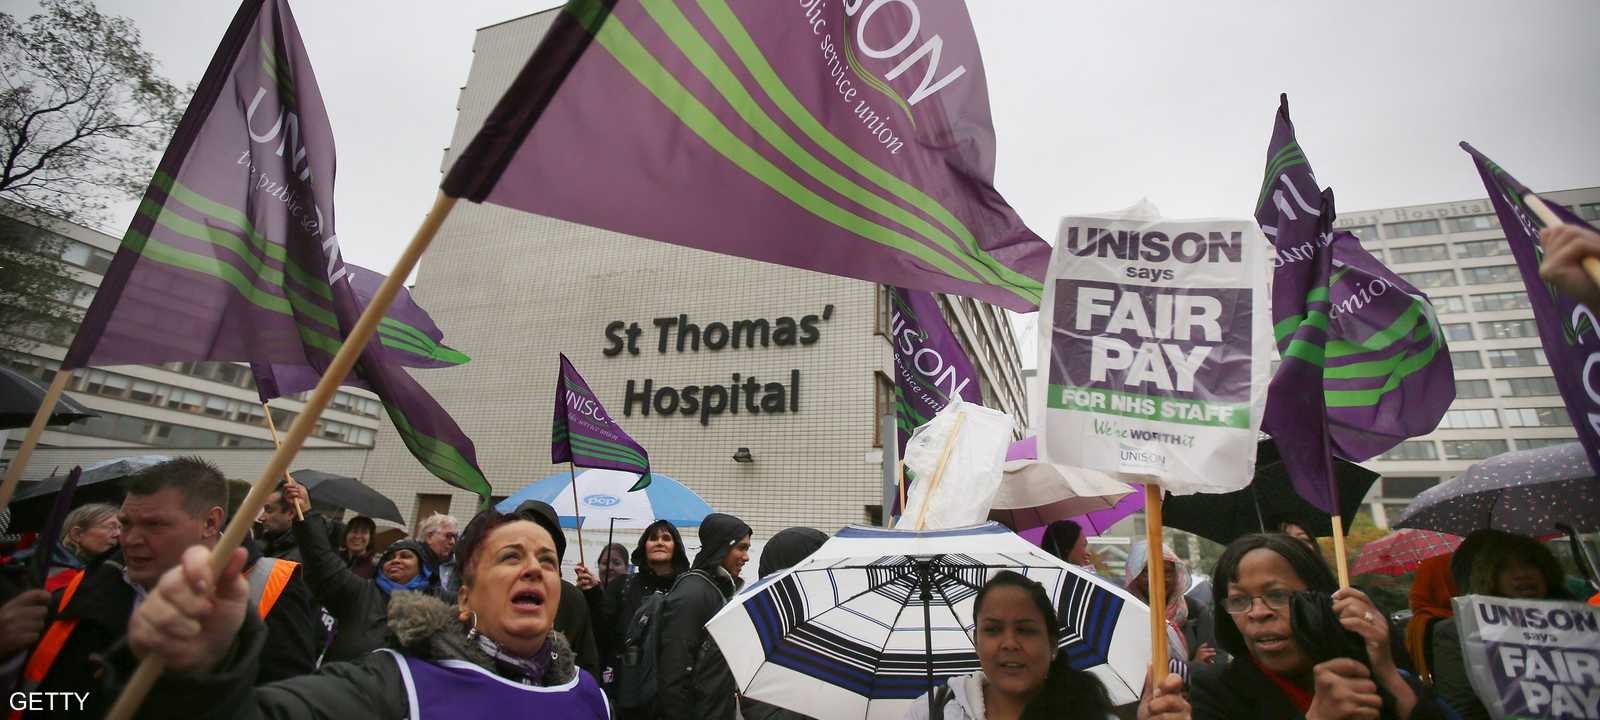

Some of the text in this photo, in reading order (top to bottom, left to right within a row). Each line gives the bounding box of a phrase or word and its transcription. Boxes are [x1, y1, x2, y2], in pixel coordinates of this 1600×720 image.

[843, 0, 966, 106] ON
[800, 0, 904, 154] lic service union
[255, 172, 304, 218] public
[1395, 200, 1492, 221] Hospital
[1067, 227, 1243, 264] UNISON
[1126, 266, 1175, 282] says
[603, 304, 834, 356] St Thomas'
[1075, 286, 1223, 342] FAIR
[1090, 336, 1213, 393] PAY
[623, 369, 800, 427] Hospital
[1062, 389, 1235, 423] FOR NHS STAFF
[1120, 450, 1166, 464] UNISON
[1479, 603, 1599, 632] UNISON
[1522, 632, 1558, 643] says
[1498, 646, 1600, 686] FAIR
[1520, 680, 1600, 719] PAY
